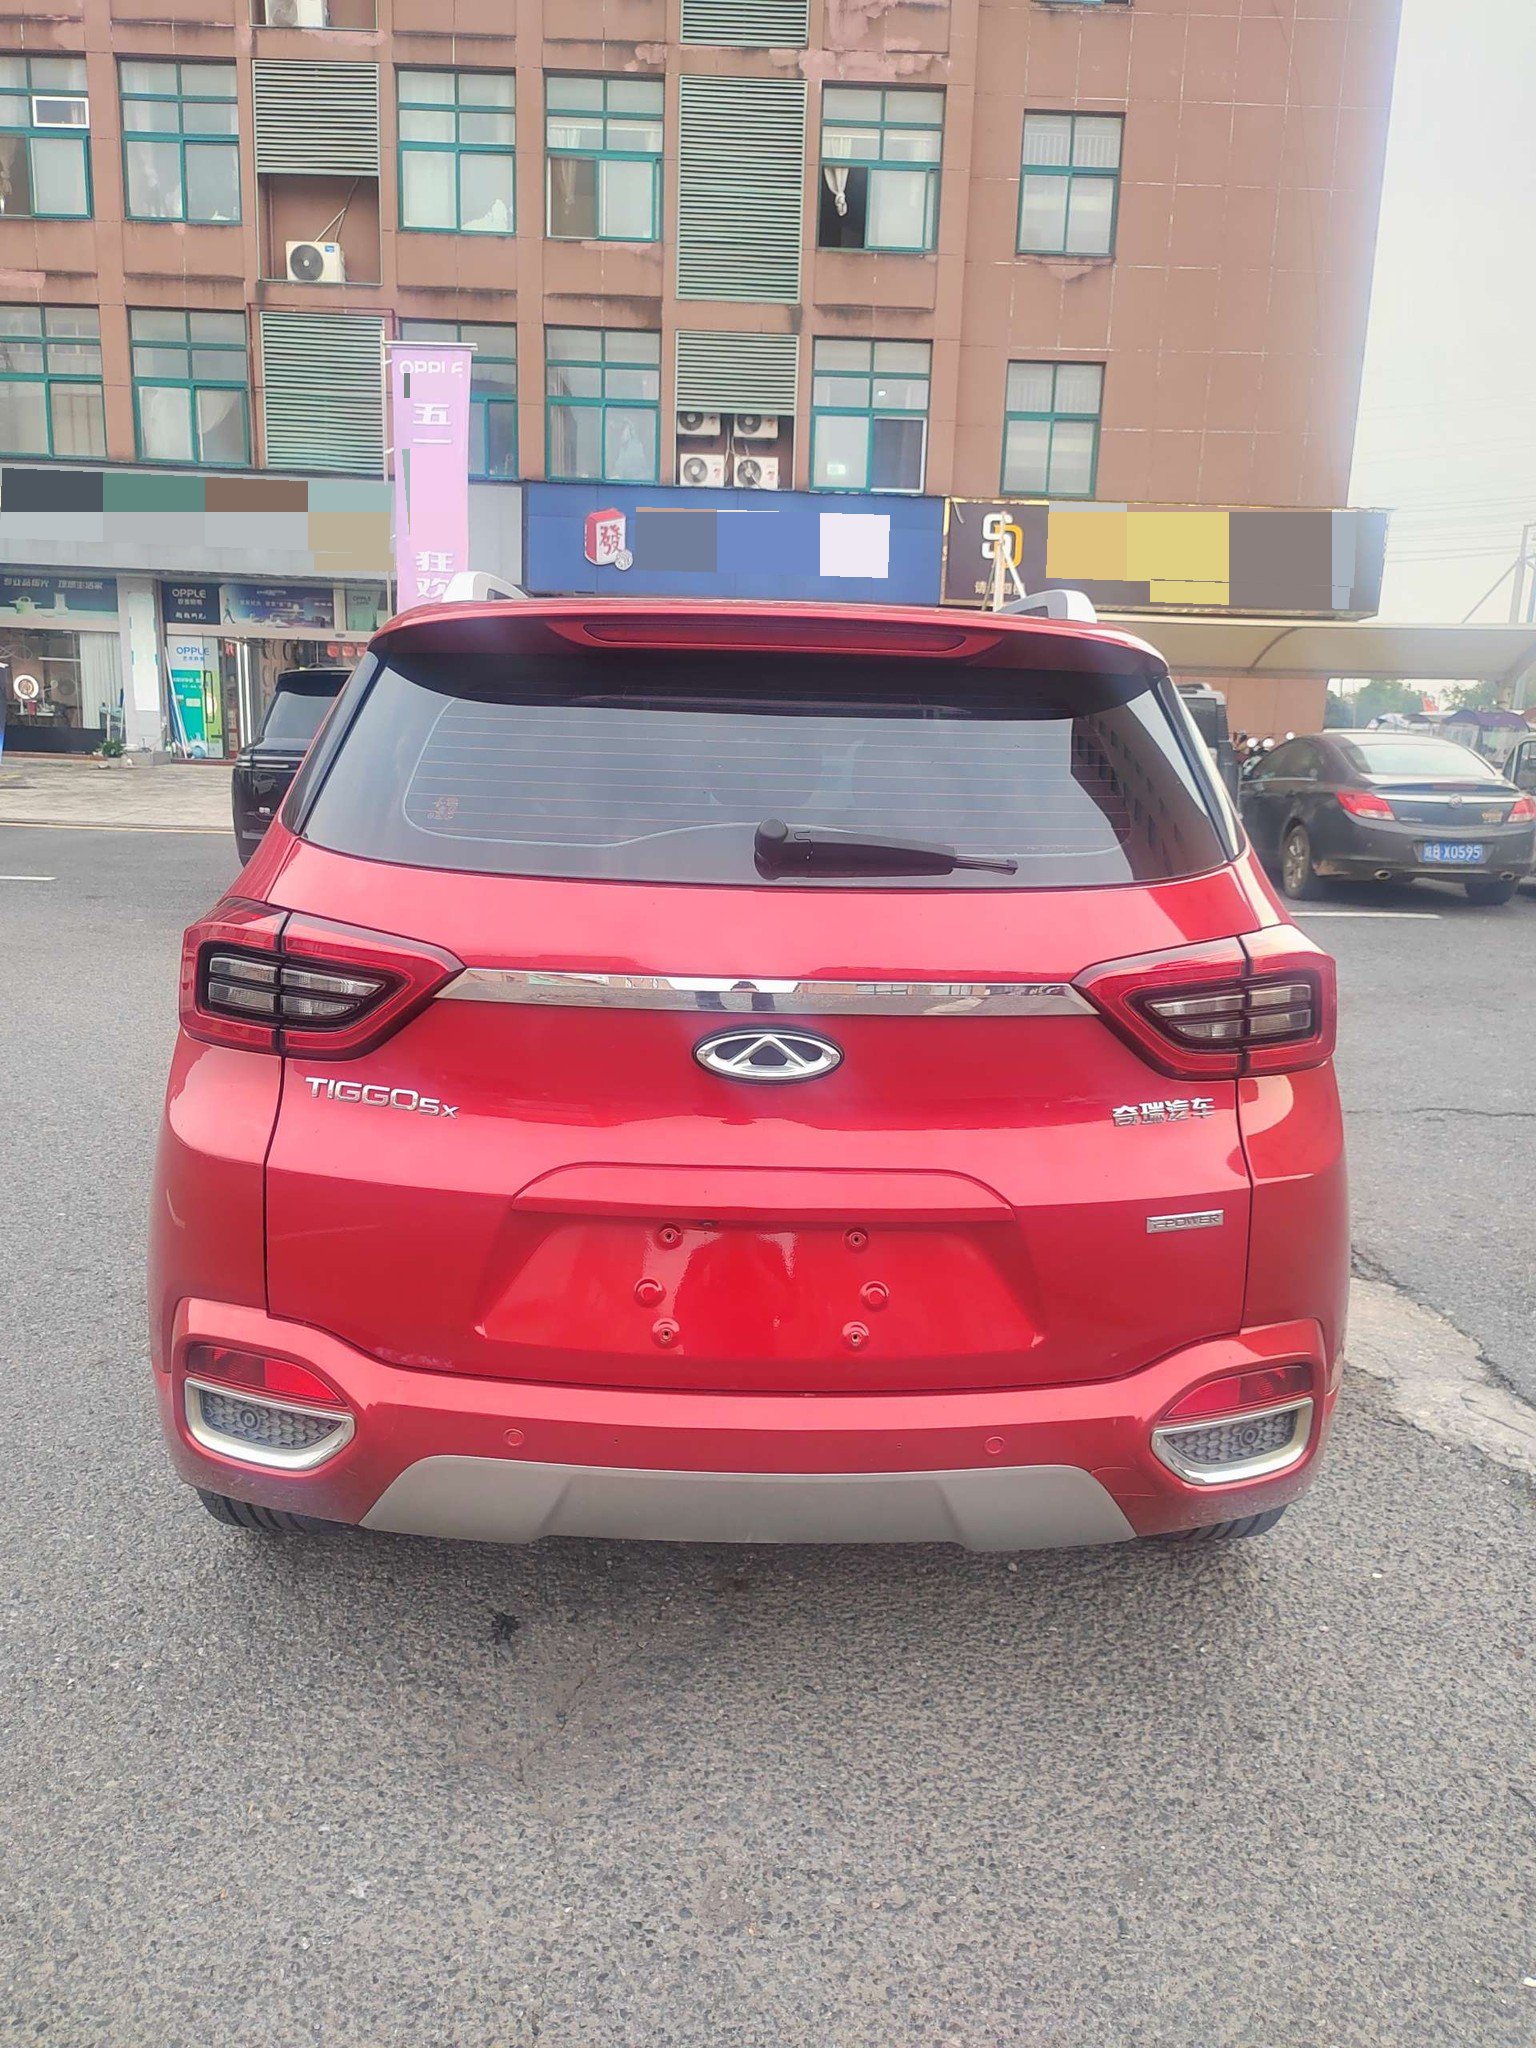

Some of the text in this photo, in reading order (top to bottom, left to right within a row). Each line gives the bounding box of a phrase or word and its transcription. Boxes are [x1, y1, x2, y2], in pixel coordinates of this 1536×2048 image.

[171, 588, 206, 599] OPPLE
[176, 646, 210, 656] OPPLE
[1112, 1097, 1215, 1127] 奇瑞汽车
